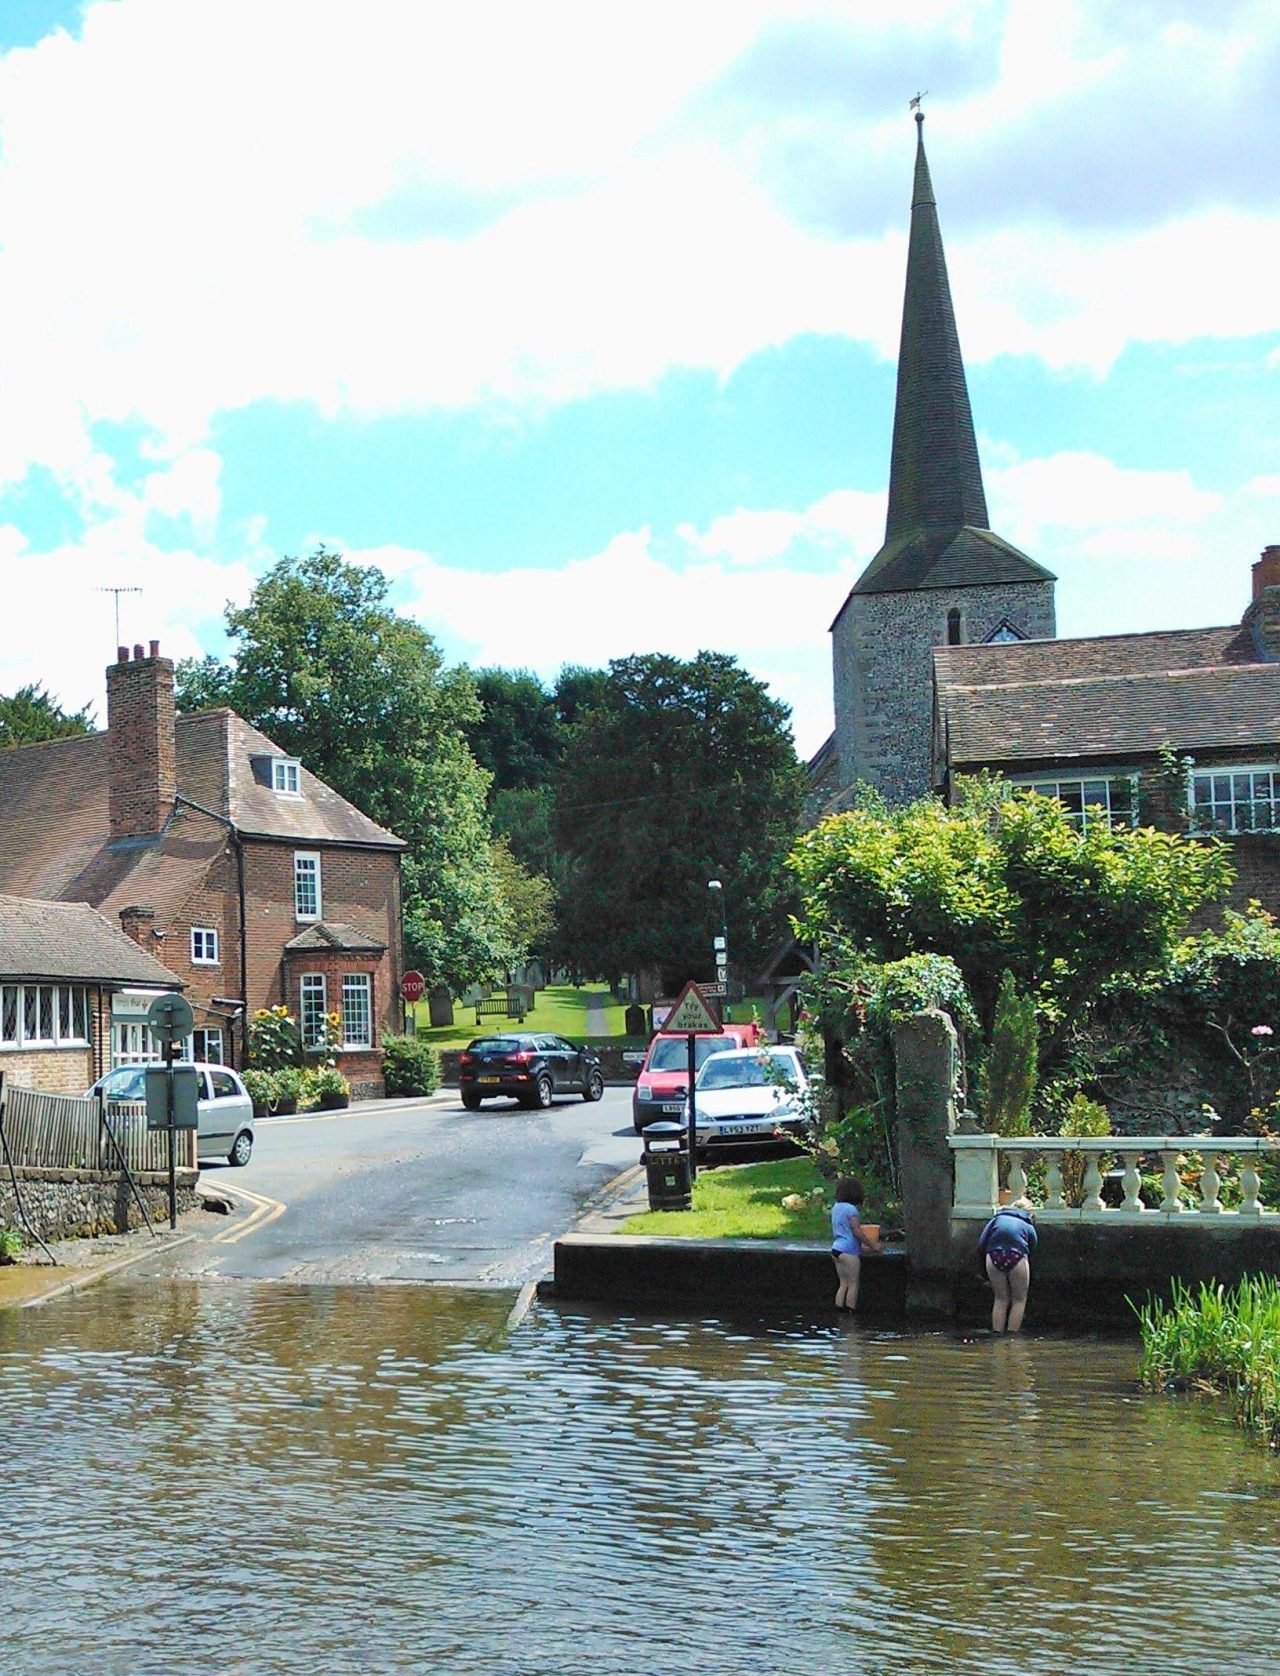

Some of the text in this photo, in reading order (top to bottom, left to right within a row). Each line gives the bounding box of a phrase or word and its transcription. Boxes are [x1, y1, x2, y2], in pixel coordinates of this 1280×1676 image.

[402, 982, 423, 992] STOP
[685, 1003, 699, 1011] Try
[683, 1012, 702, 1020] your
[677, 1021, 708, 1029] brakes
